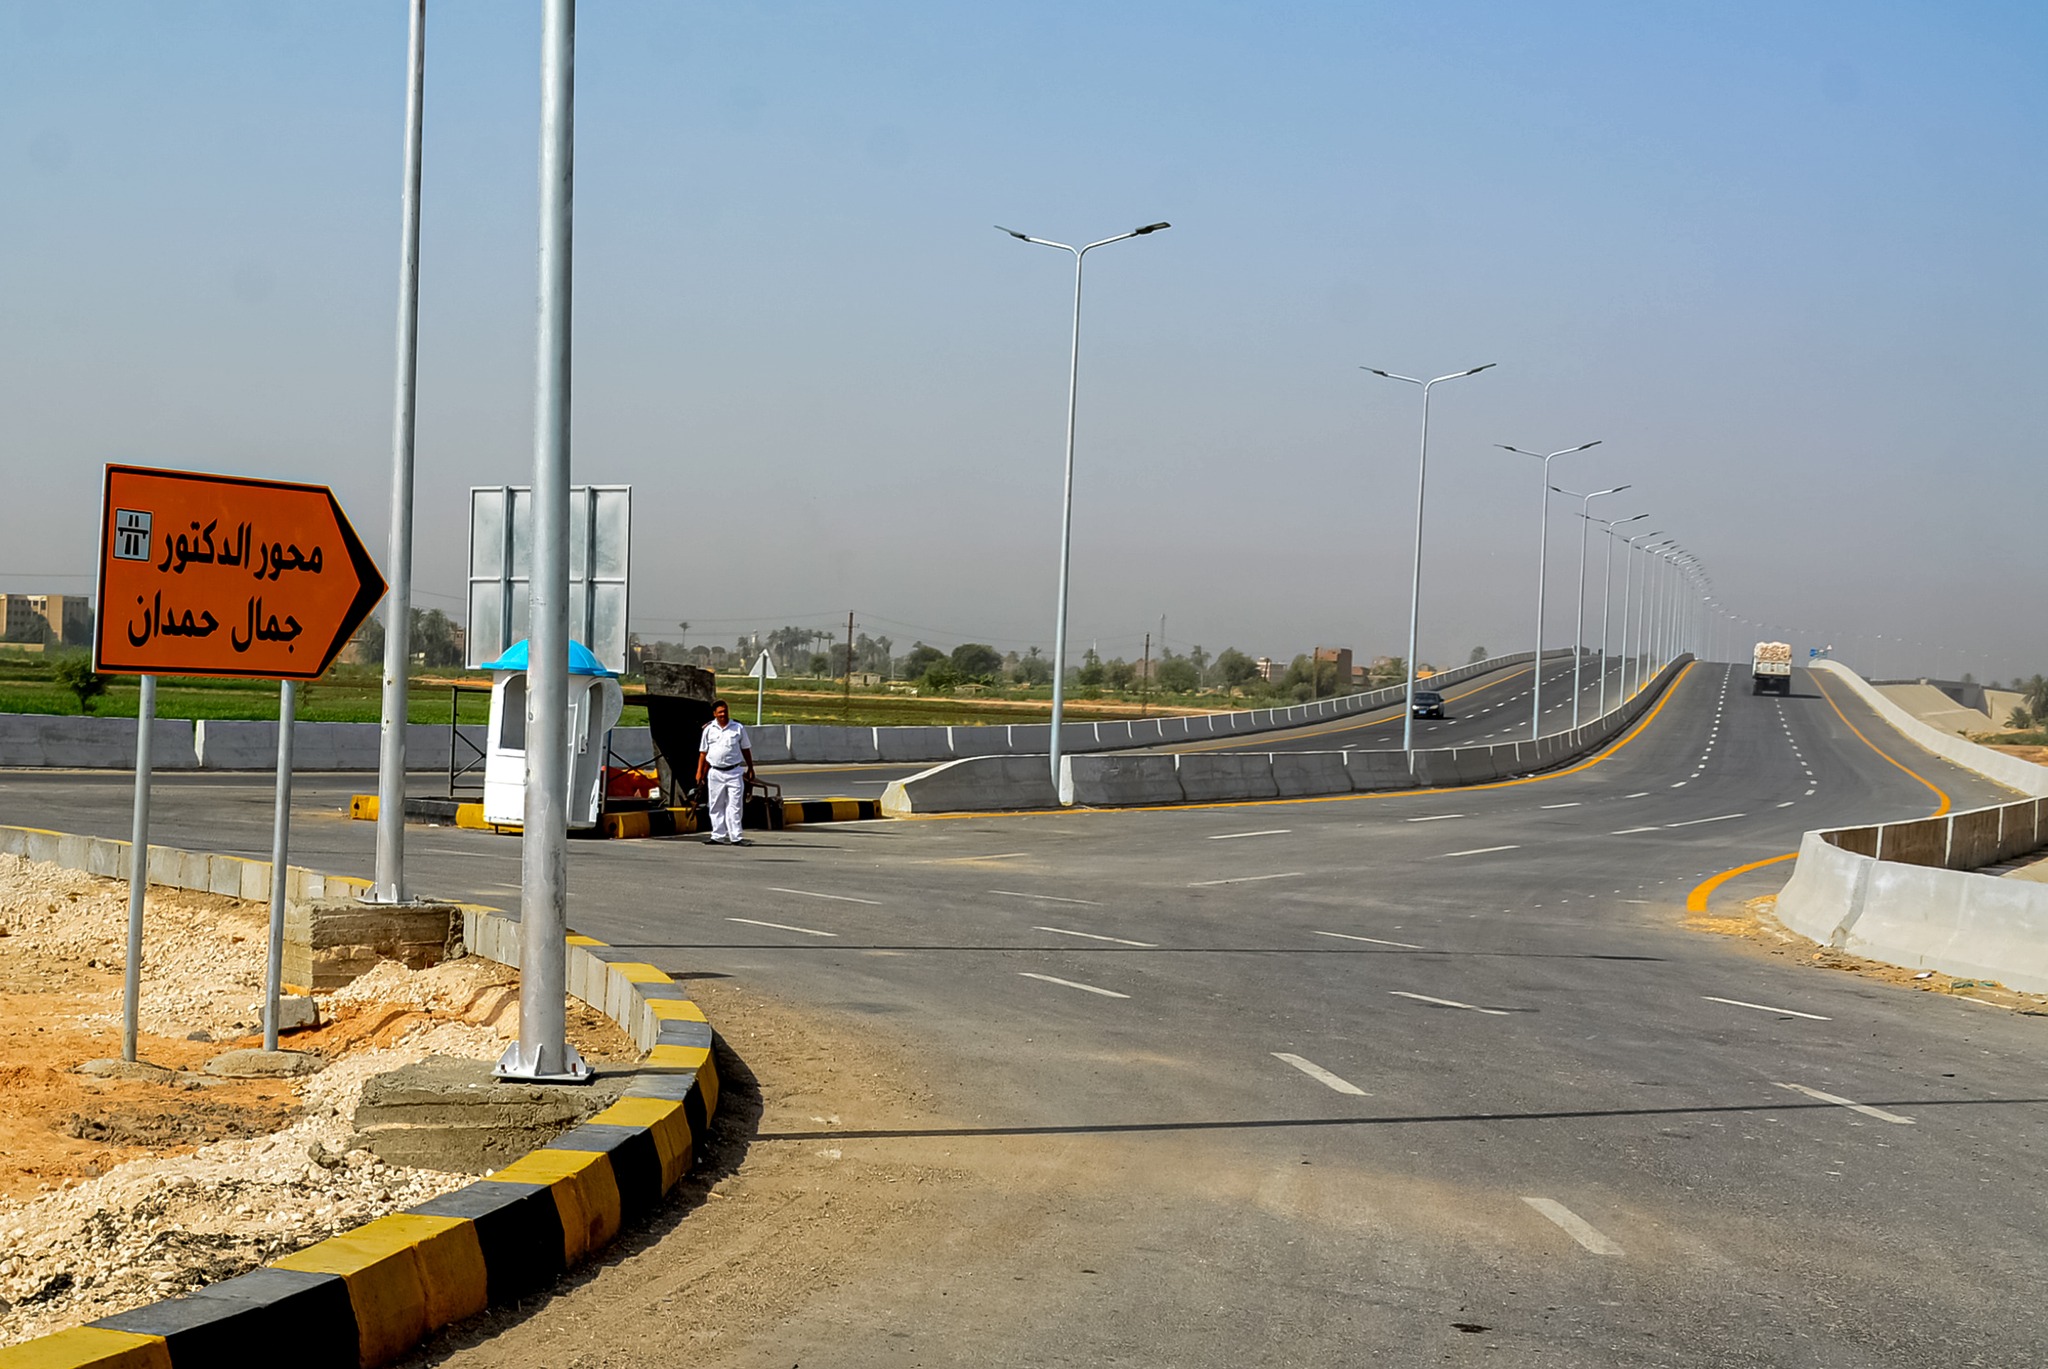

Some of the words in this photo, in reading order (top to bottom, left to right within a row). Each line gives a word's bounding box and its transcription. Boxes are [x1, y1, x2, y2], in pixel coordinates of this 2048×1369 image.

[157, 518, 252, 574] الدكتور
[253, 541, 323, 581] محور
[127, 589, 219, 647] حمدان
[230, 596, 303, 654] جمال
